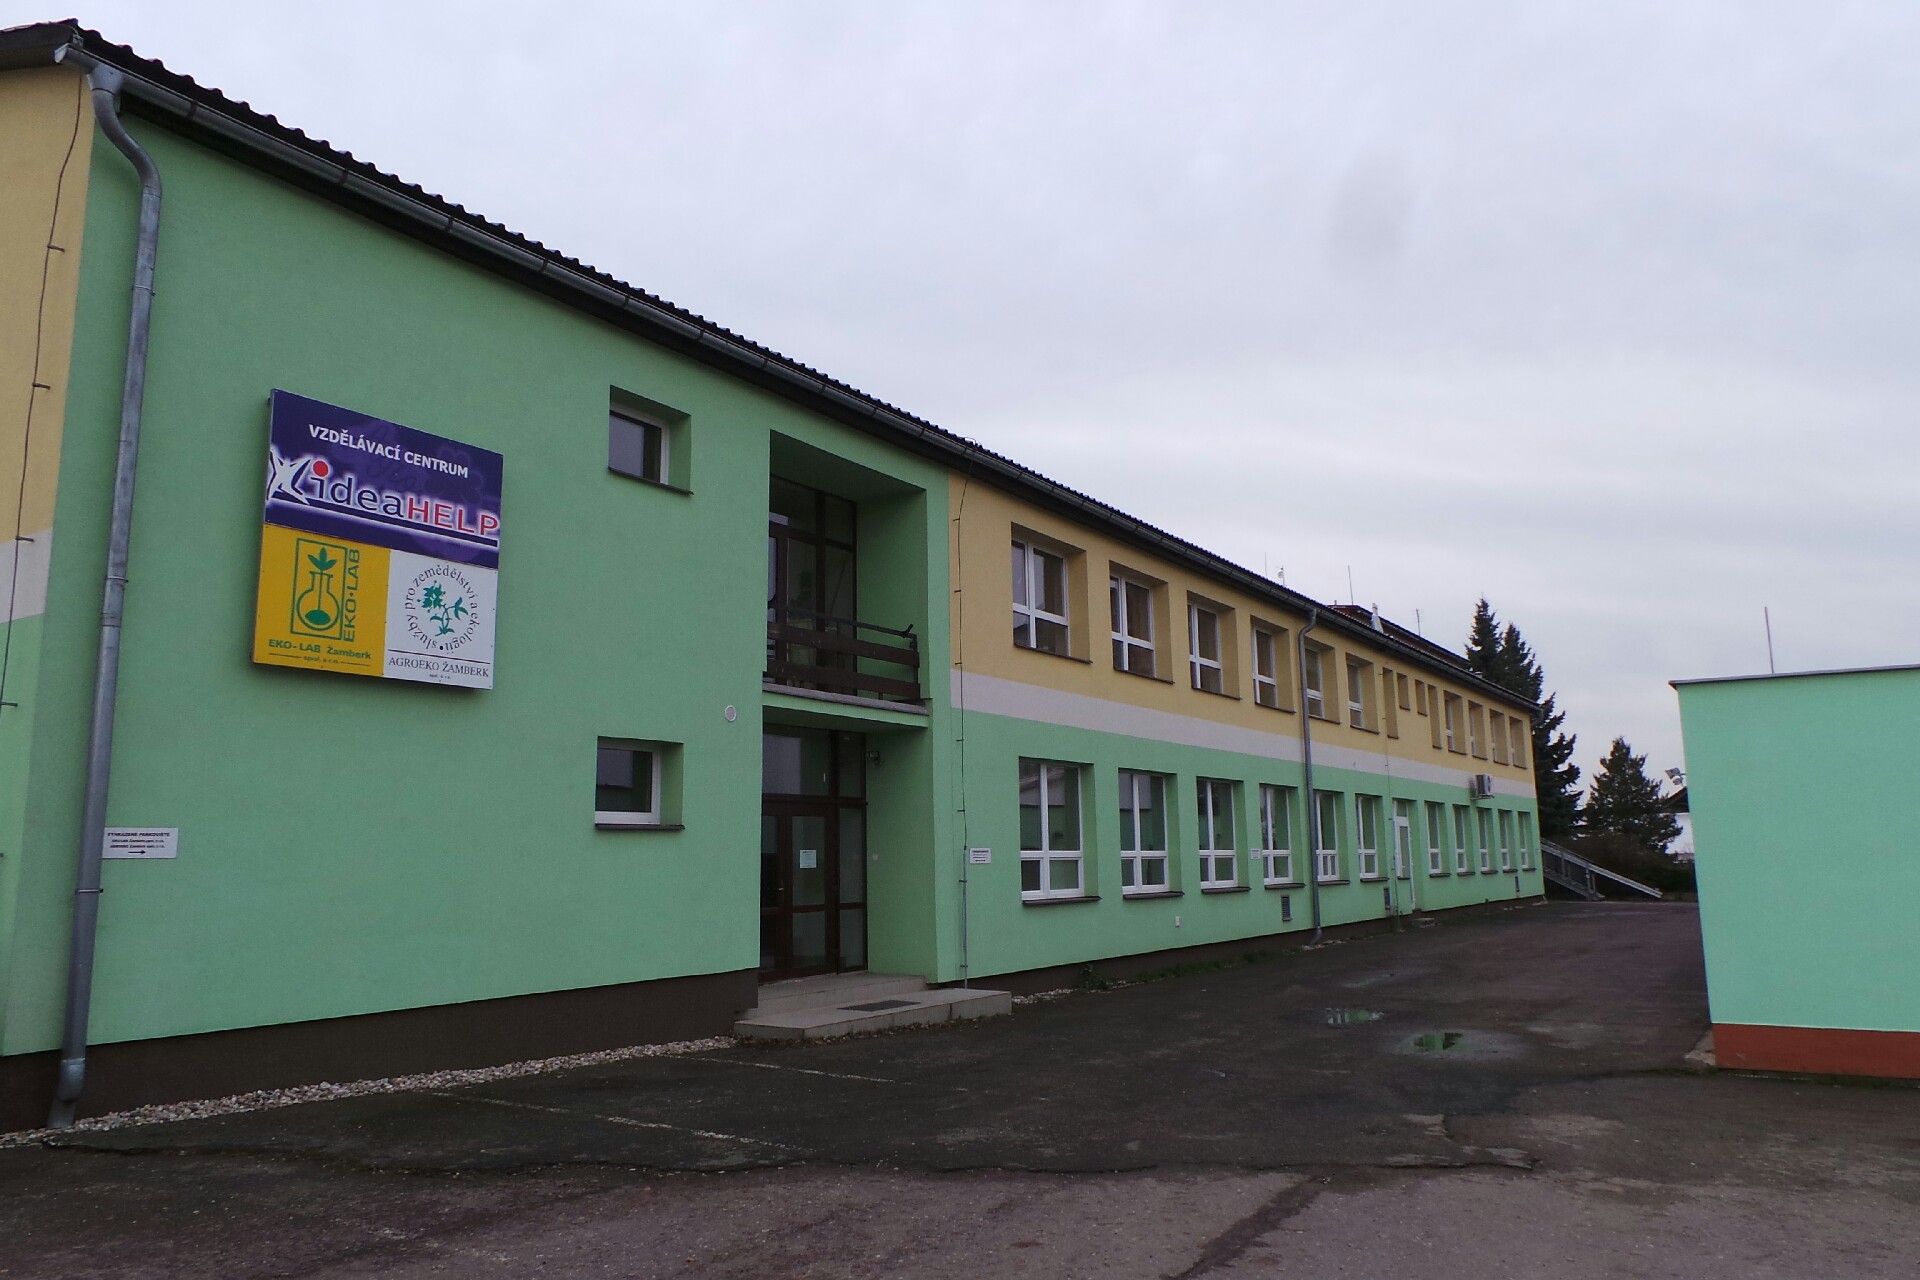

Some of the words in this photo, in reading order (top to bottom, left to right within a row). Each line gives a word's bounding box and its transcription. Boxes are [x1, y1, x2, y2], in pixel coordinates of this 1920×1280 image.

[308, 424, 401, 460] VZDĚLÁVACÍ
[404, 451, 468, 478] CENTRUM
[405, 587, 416, 610] pro
[413, 565, 478, 599] zemědělství
[327, 645, 371, 659] Žamberk
[388, 657, 440, 671] AGROEKO
[442, 661, 489, 677] ŽAMBERK
